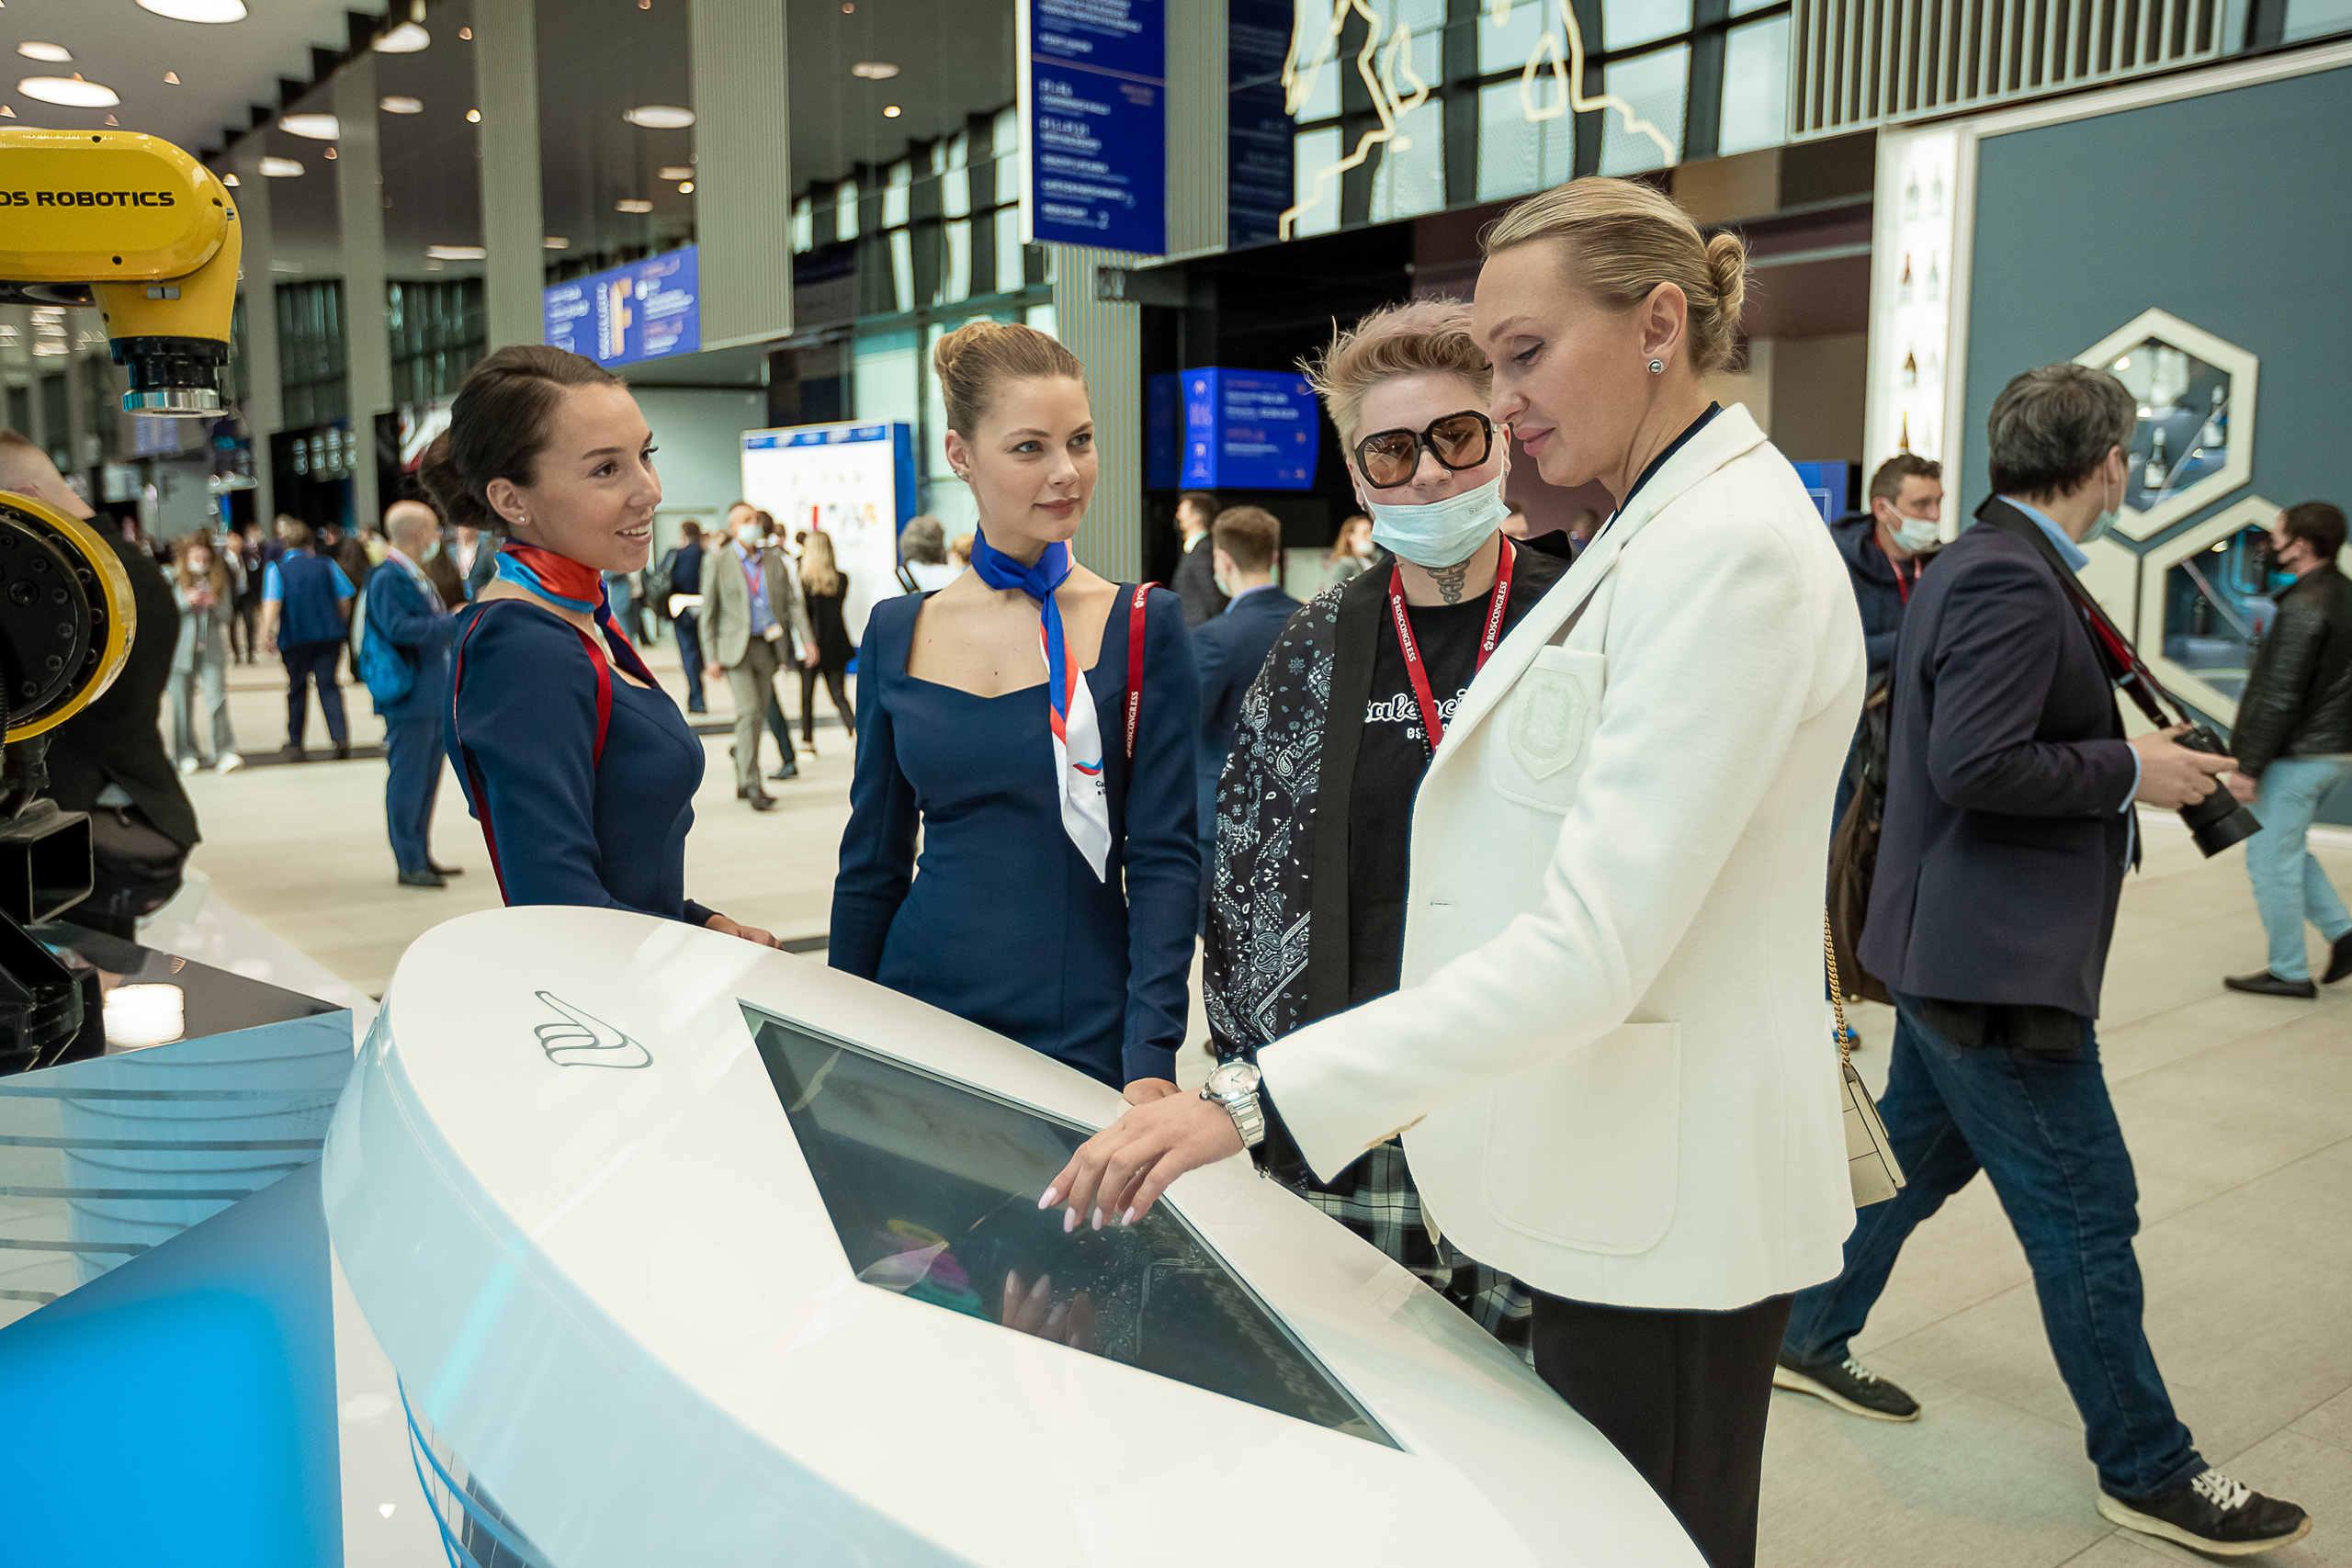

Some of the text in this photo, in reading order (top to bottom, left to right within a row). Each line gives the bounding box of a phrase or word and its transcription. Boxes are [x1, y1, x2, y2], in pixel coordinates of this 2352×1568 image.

[36, 191, 175, 207] ROBOTICS
[1395, 603, 1417, 662] ROSCONGRESS
[1487, 581, 1508, 642] ROSCONGRESS
